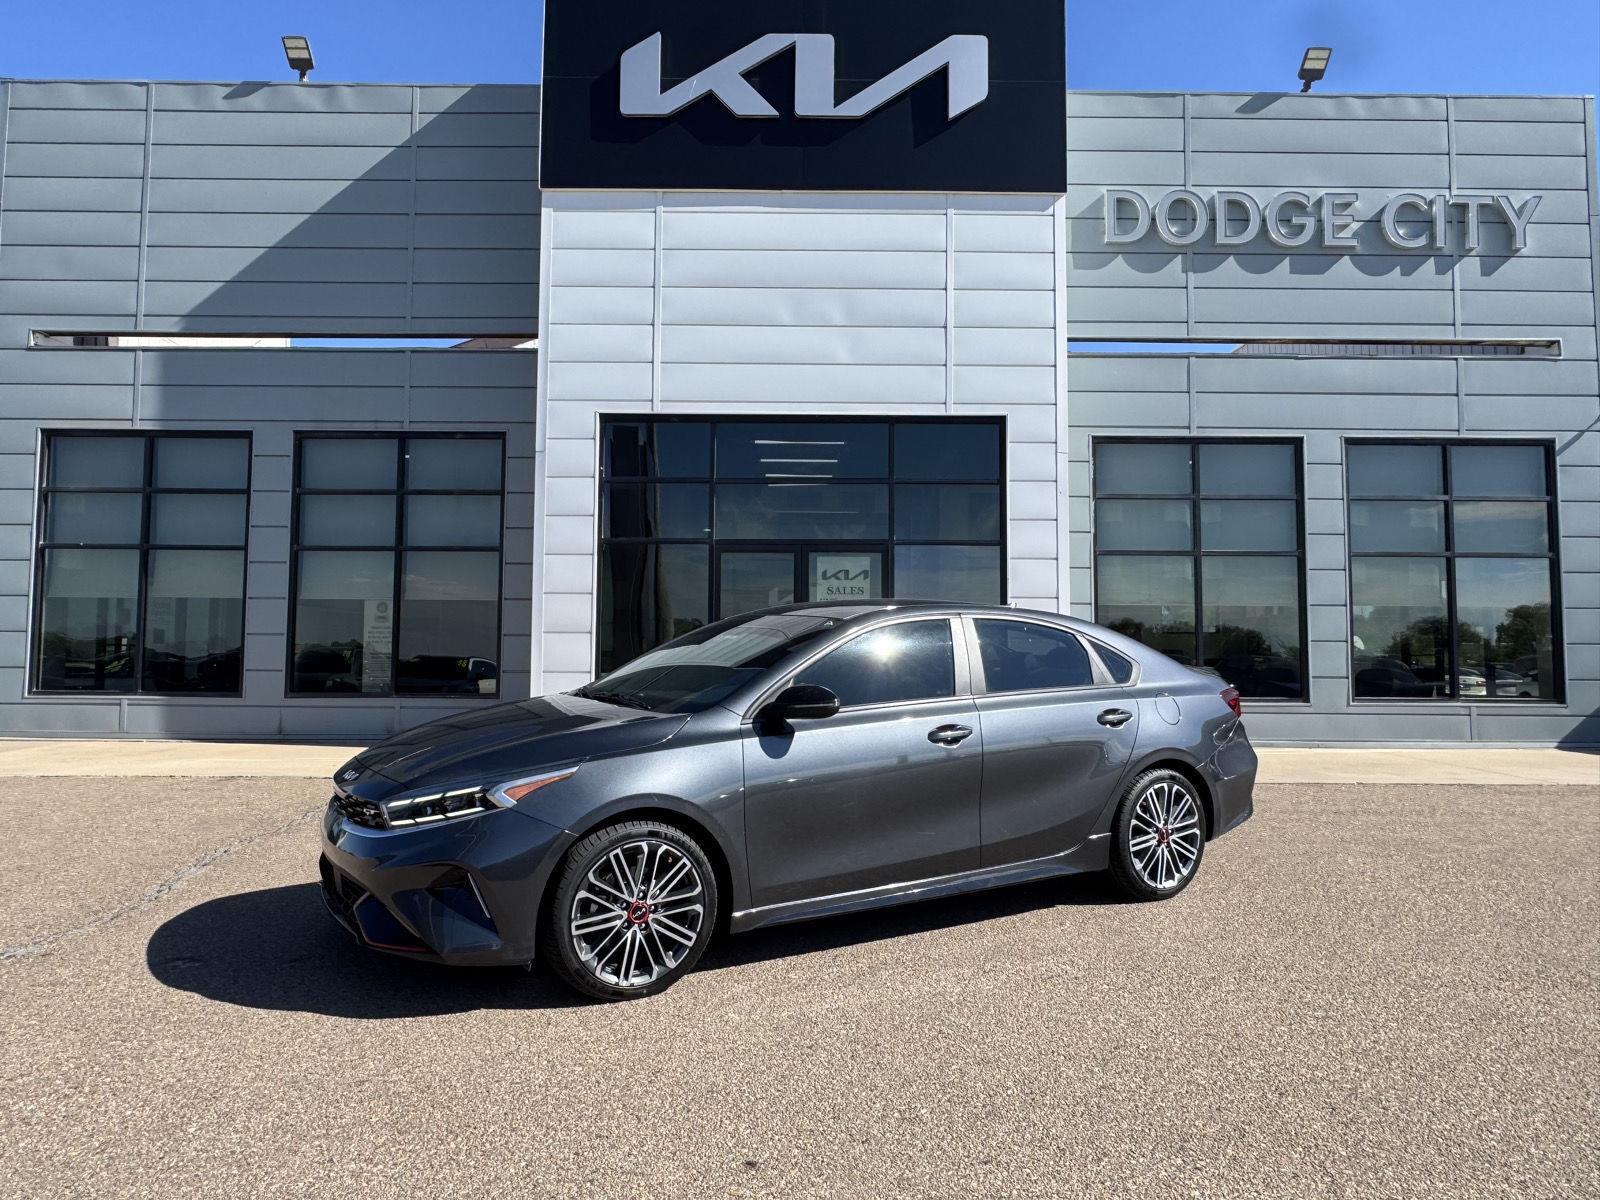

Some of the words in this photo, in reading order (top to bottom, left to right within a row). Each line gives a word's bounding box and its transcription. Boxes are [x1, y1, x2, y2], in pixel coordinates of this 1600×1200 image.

[620, 32, 989, 121] KIA
[1104, 189, 1359, 248] DODGE
[1381, 193, 1543, 249] CITY
[821, 569, 869, 581] KIA
[826, 586, 865, 596] SALES
